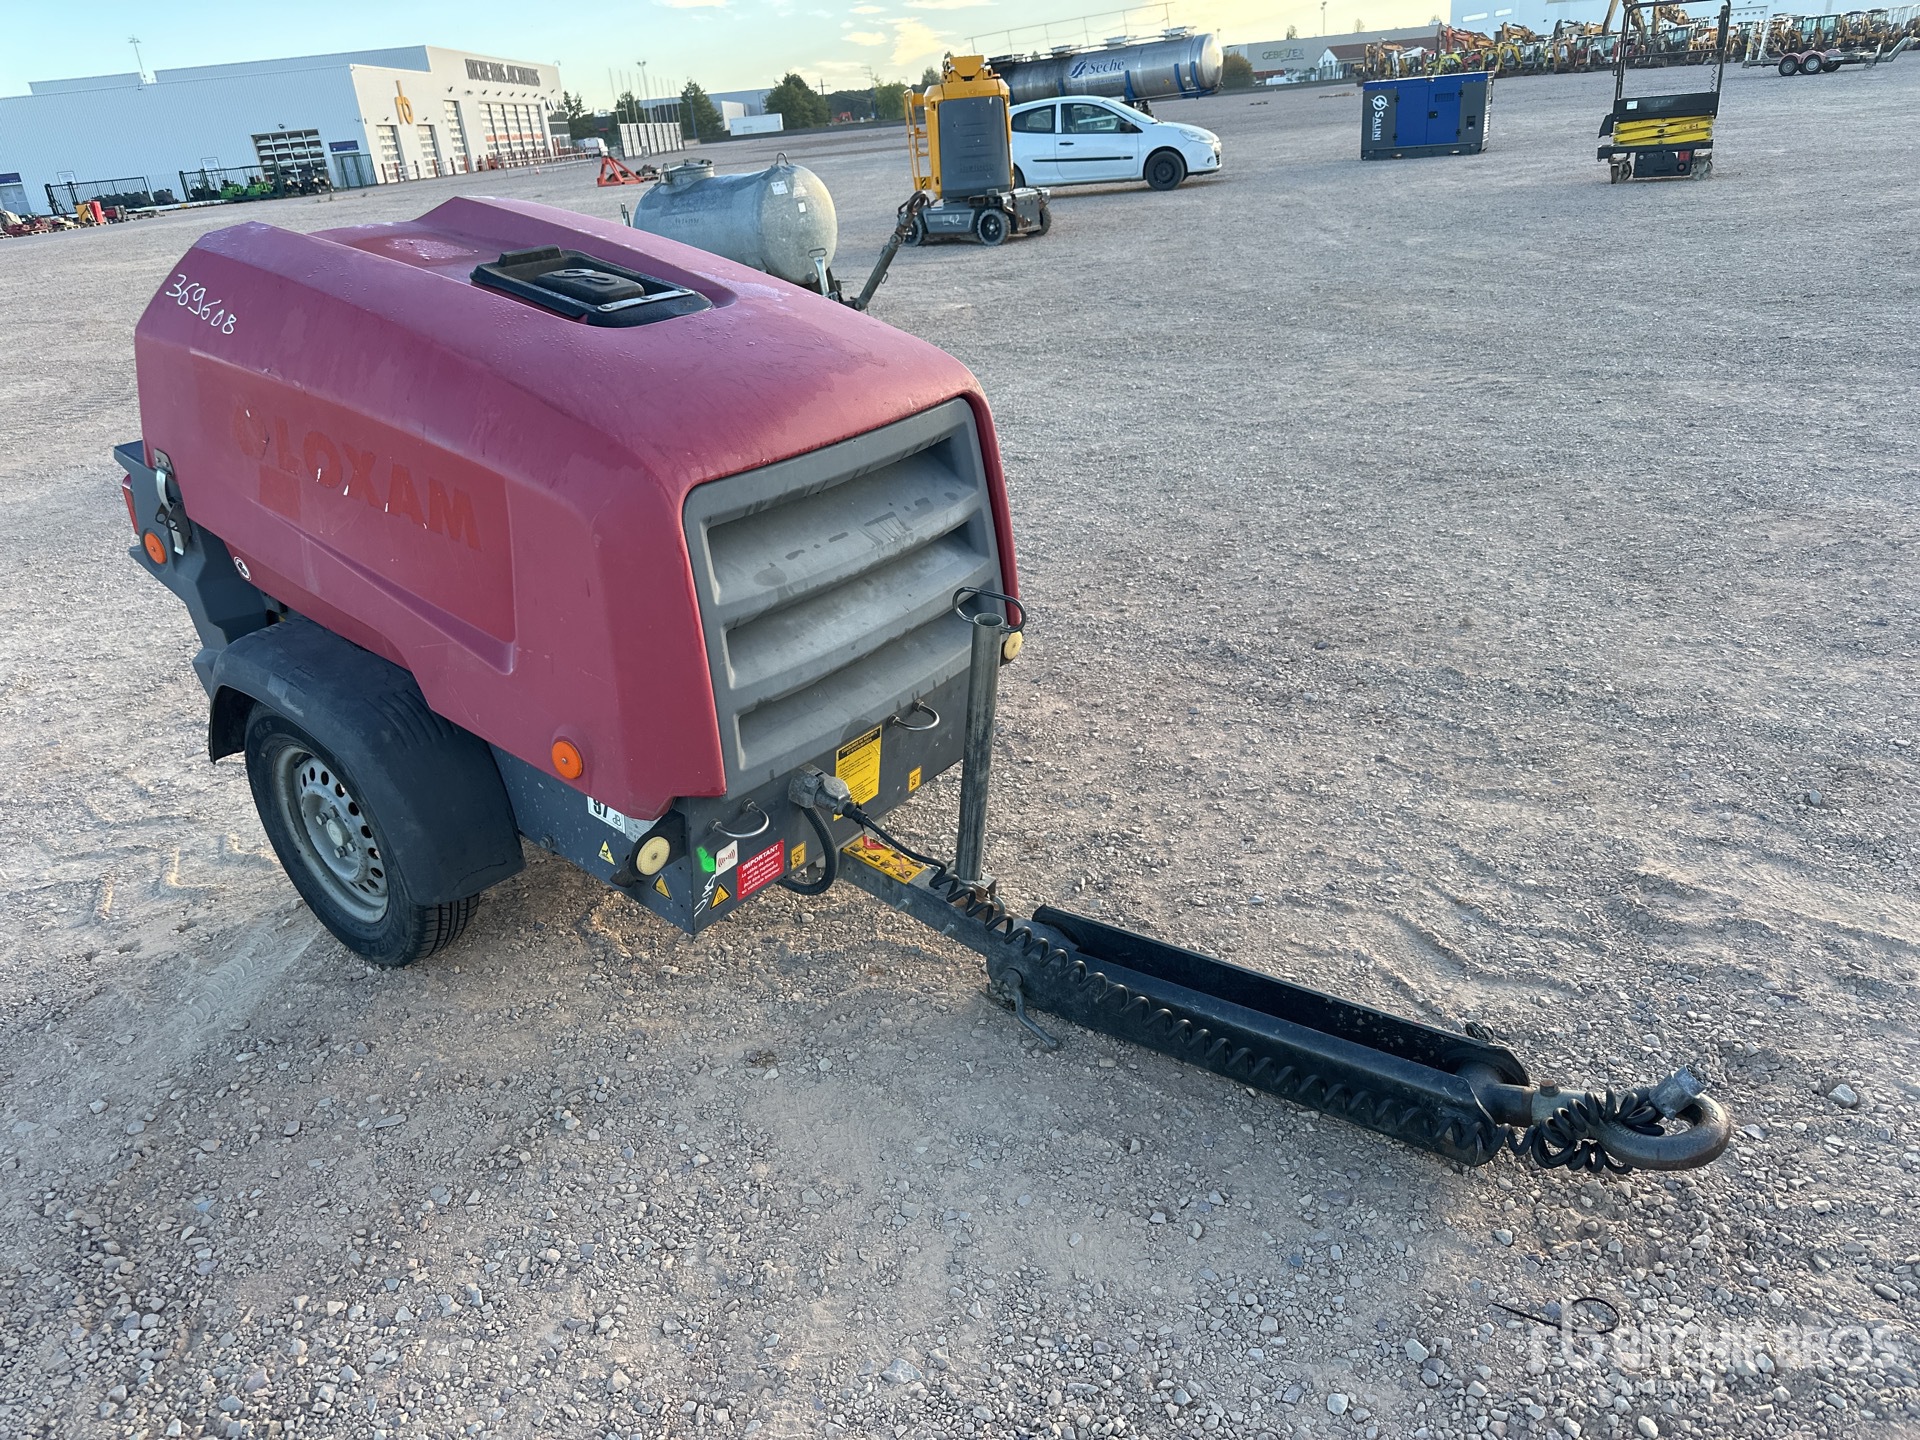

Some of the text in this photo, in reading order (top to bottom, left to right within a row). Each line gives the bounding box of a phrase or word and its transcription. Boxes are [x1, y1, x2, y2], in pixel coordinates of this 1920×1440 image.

[1374, 111, 1384, 141] SALINI
[165, 273, 237, 335] 369608
[274, 415, 482, 552] LOXAM
[743, 844, 779, 870] IMPORTANT
